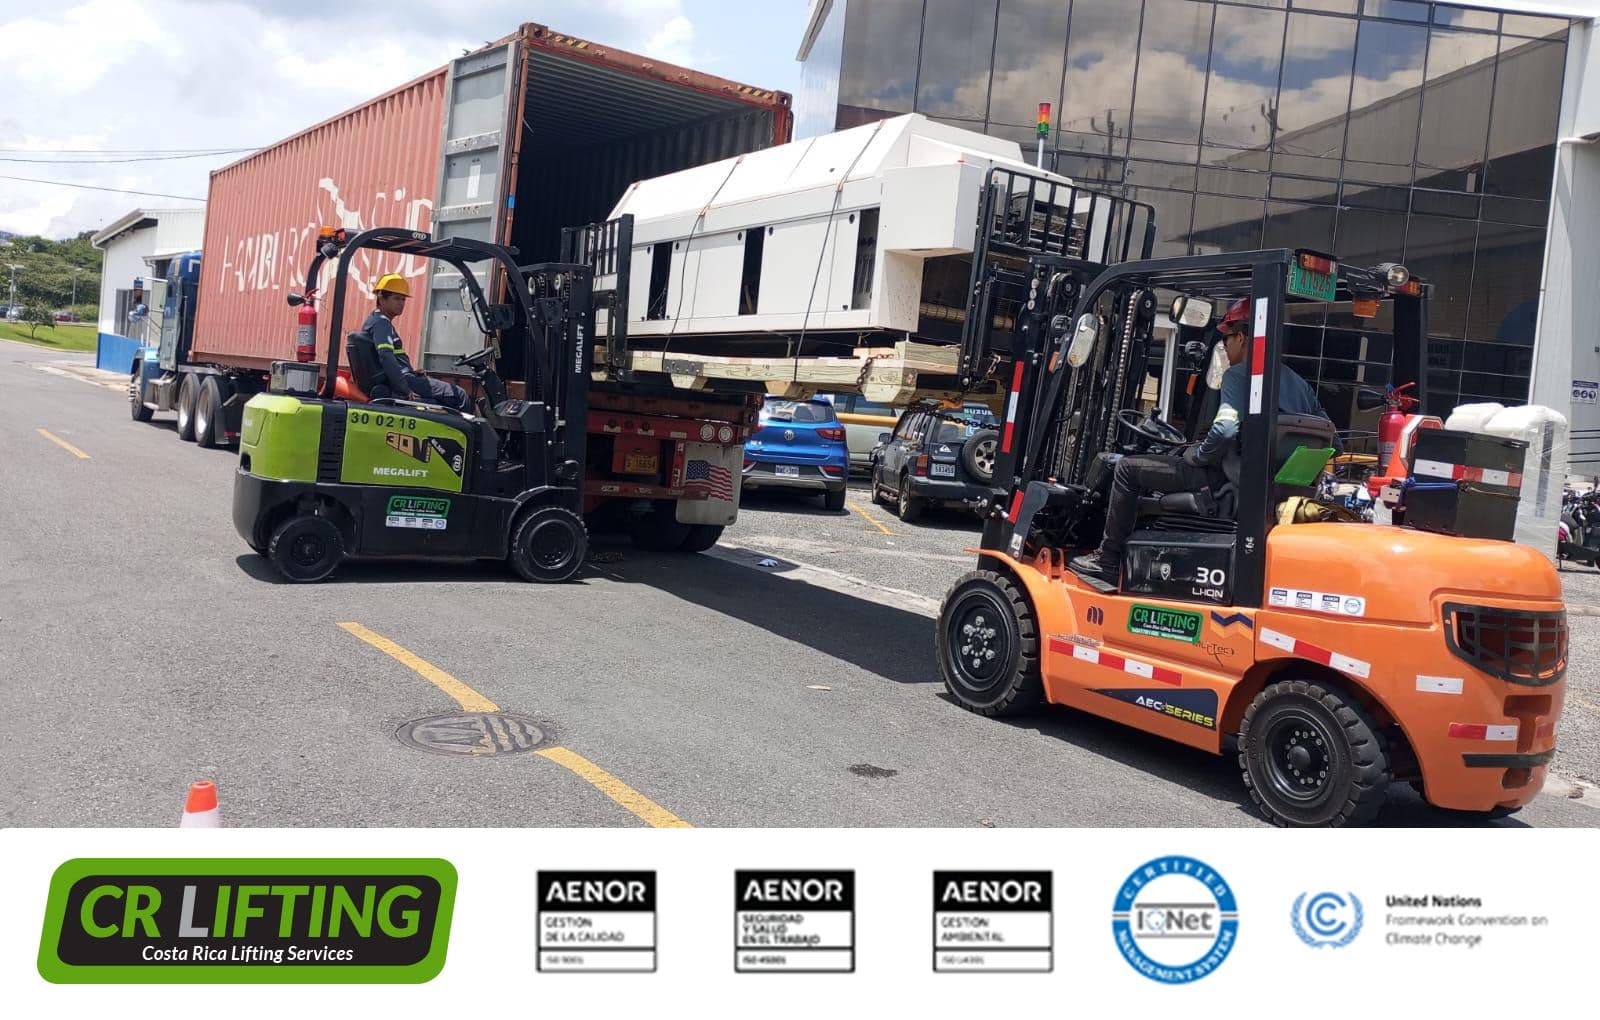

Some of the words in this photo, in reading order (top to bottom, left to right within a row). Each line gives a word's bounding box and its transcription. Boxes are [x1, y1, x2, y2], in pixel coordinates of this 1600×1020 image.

[575, 324, 584, 373] MEGALIFT
[351, 413, 370, 425] 30
[376, 415, 416, 430] 0218
[373, 466, 429, 478] MEGALIFT
[407, 500, 446, 511] LIFTING
[1195, 567, 1226, 586] 30
[1134, 609, 1149, 623] CR
[1150, 611, 1196, 631] LIFTING
